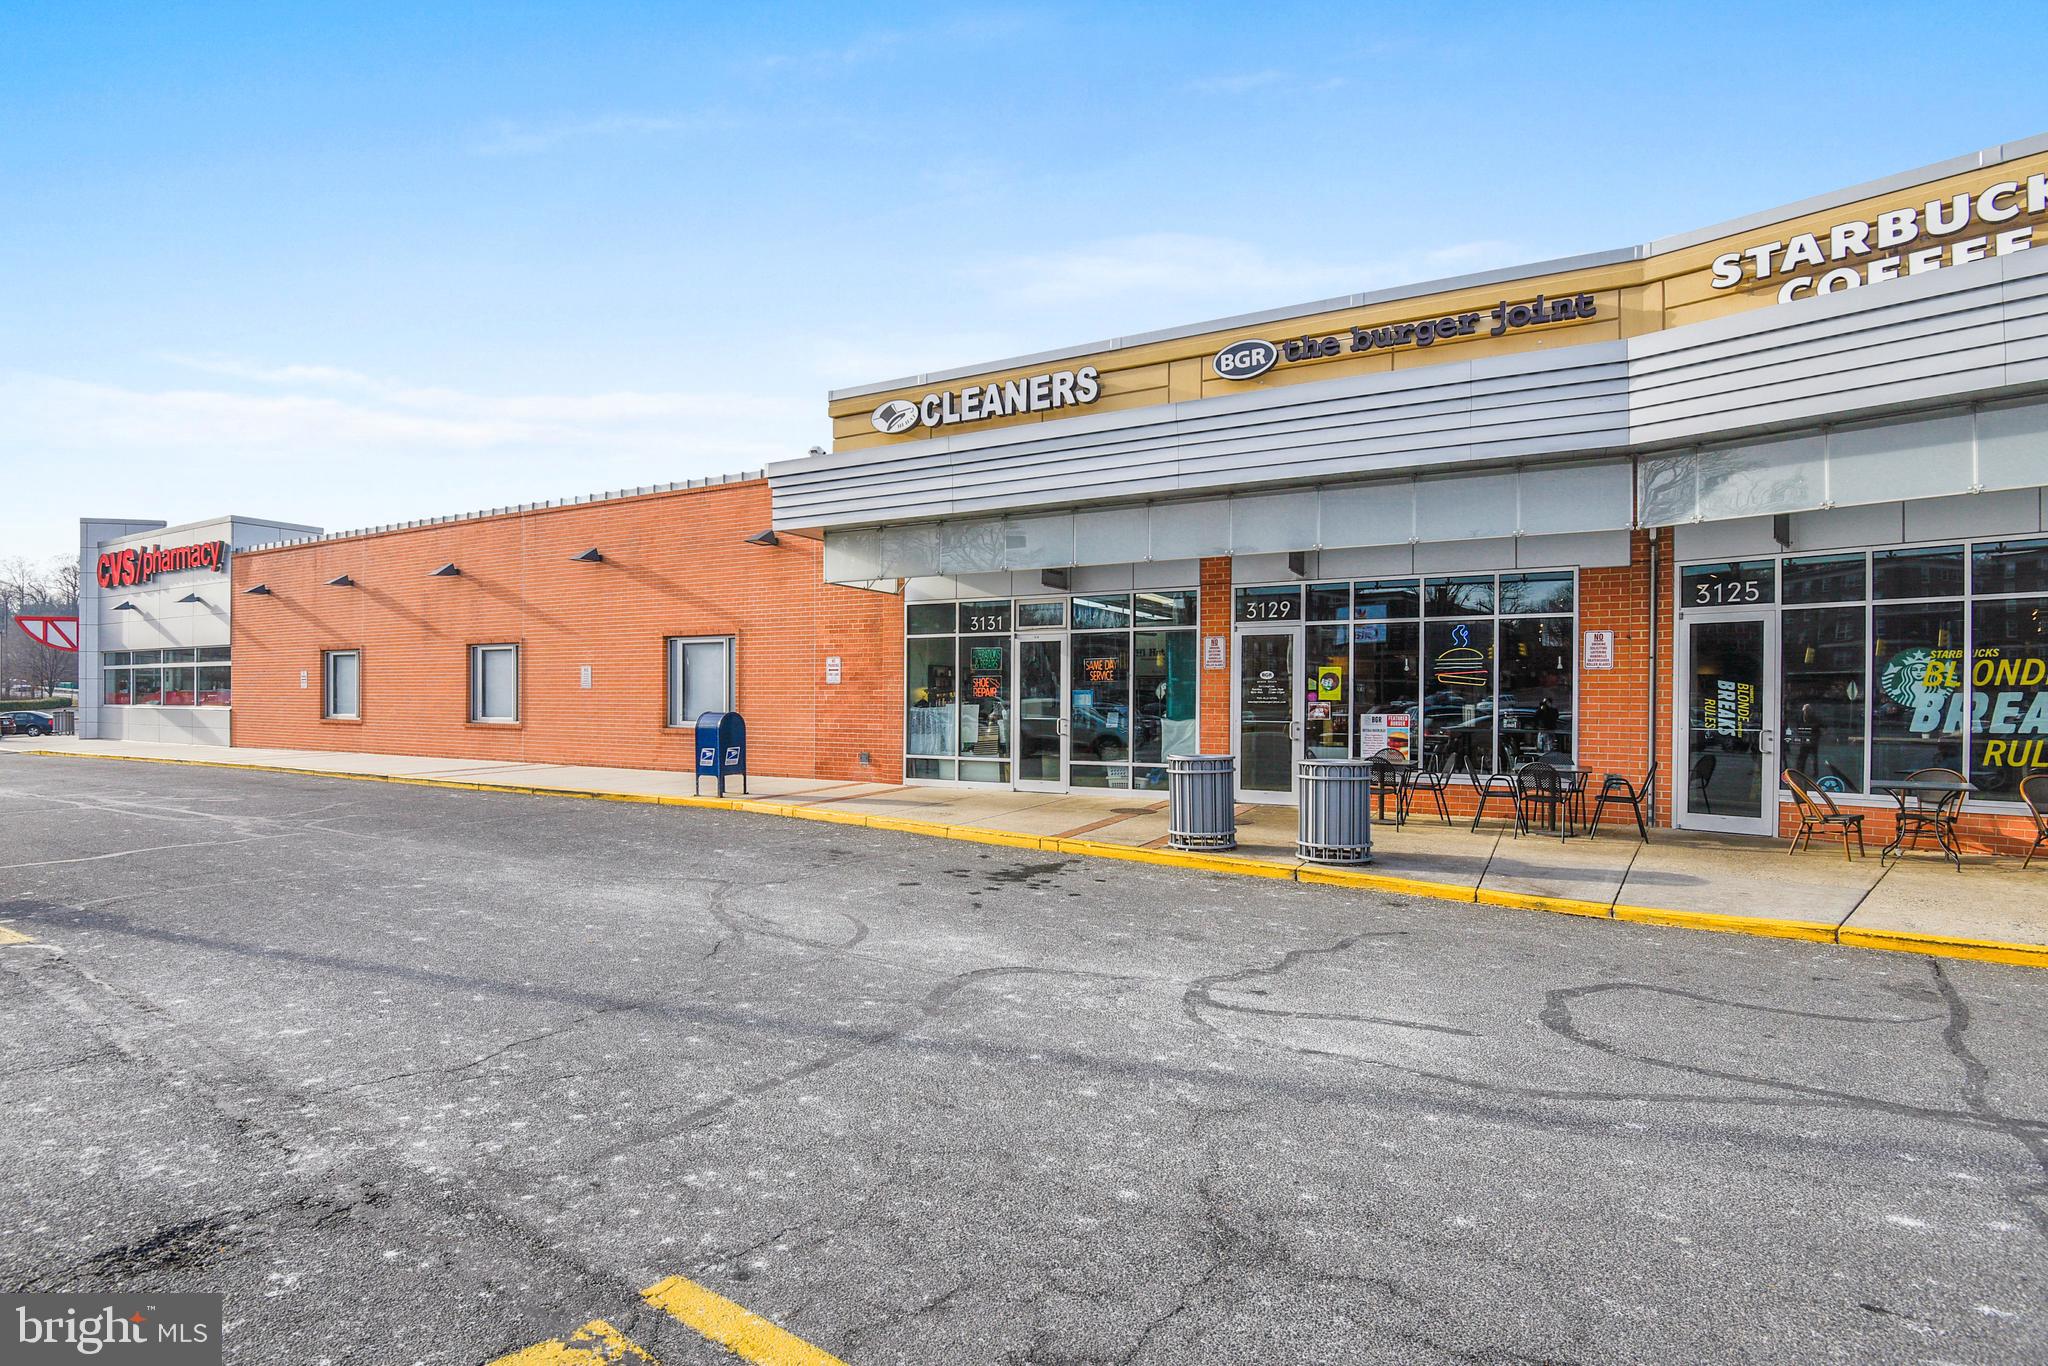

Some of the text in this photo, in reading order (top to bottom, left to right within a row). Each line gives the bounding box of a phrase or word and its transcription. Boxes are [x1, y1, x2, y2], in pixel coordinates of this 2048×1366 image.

[1283, 292, 1597, 362] the burger joint
[1220, 347, 1266, 372] BGR
[920, 366, 1101, 428] CLEANERS
[97, 540, 223, 588] CVS/pharmacy
[1696, 581, 1759, 604] 3125
[1246, 601, 1291, 619] 3129
[970, 616, 1002, 631] 3131
[1086, 659, 1117, 670] SAME DAY
[1090, 671, 1114, 680] SERVICE
[1922, 658, 2048, 687] BLOND
[973, 678, 989, 687] SHOE
[973, 688, 997, 697] REPAIR
[1705, 699, 1716, 729] RULES
[1718, 680, 1735, 736] BREAKS
[1737, 683, 1749, 722] BLONDE
